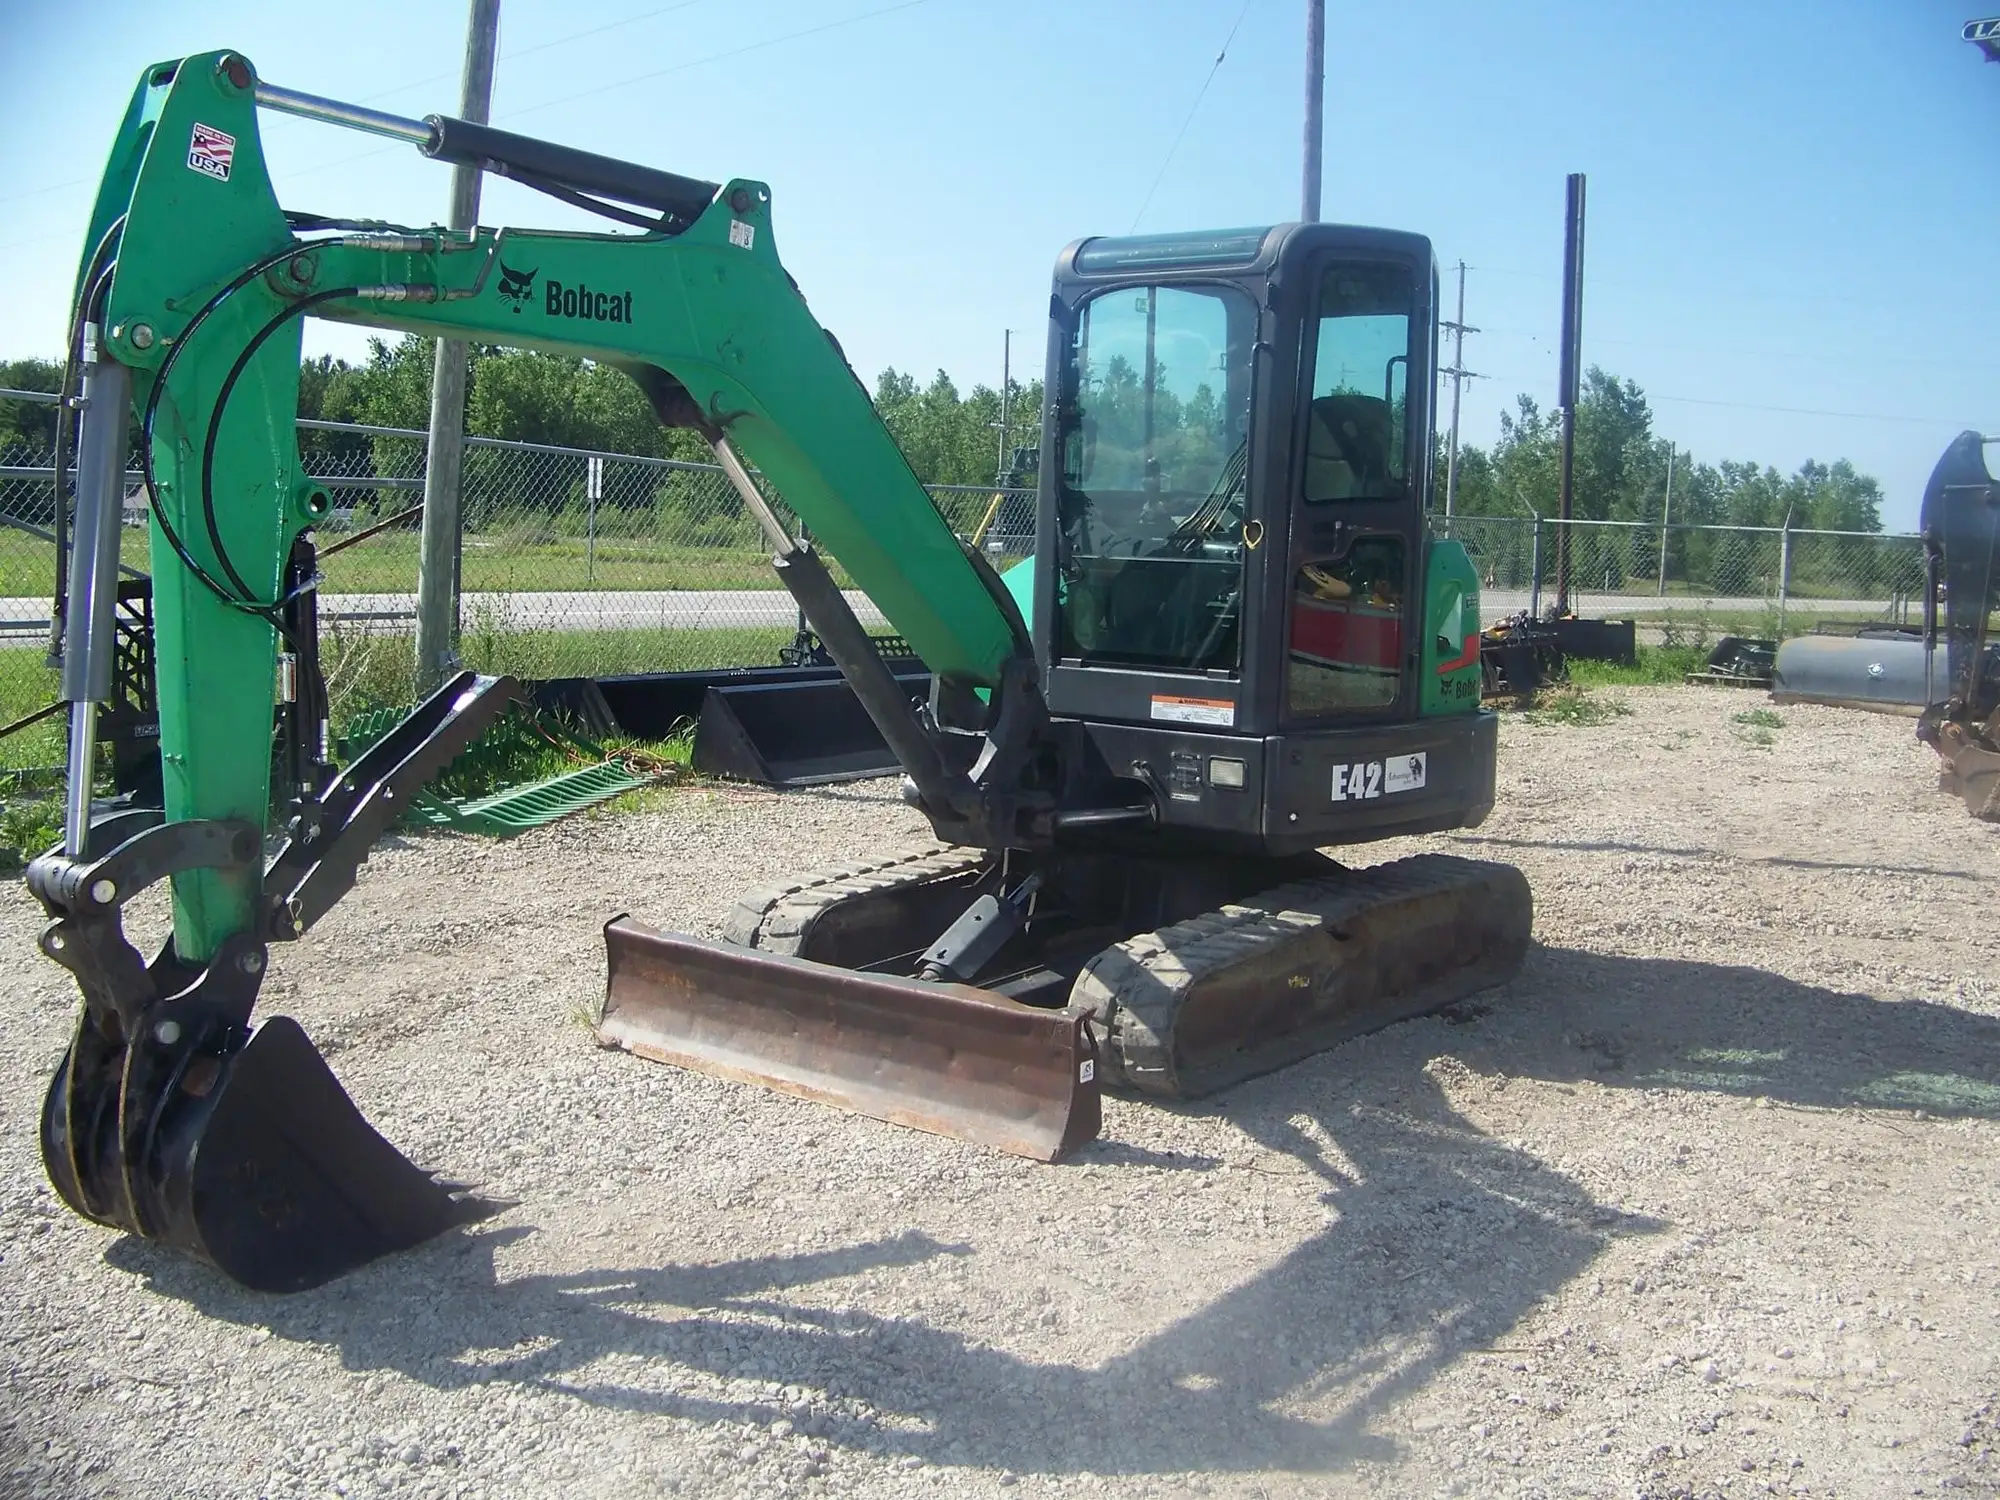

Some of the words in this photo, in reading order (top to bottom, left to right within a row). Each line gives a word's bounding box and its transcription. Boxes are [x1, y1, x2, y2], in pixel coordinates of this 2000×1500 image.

[191, 154, 226, 177] USA
[546, 280, 632, 324] Bobcat
[1331, 761, 1381, 801] E42
